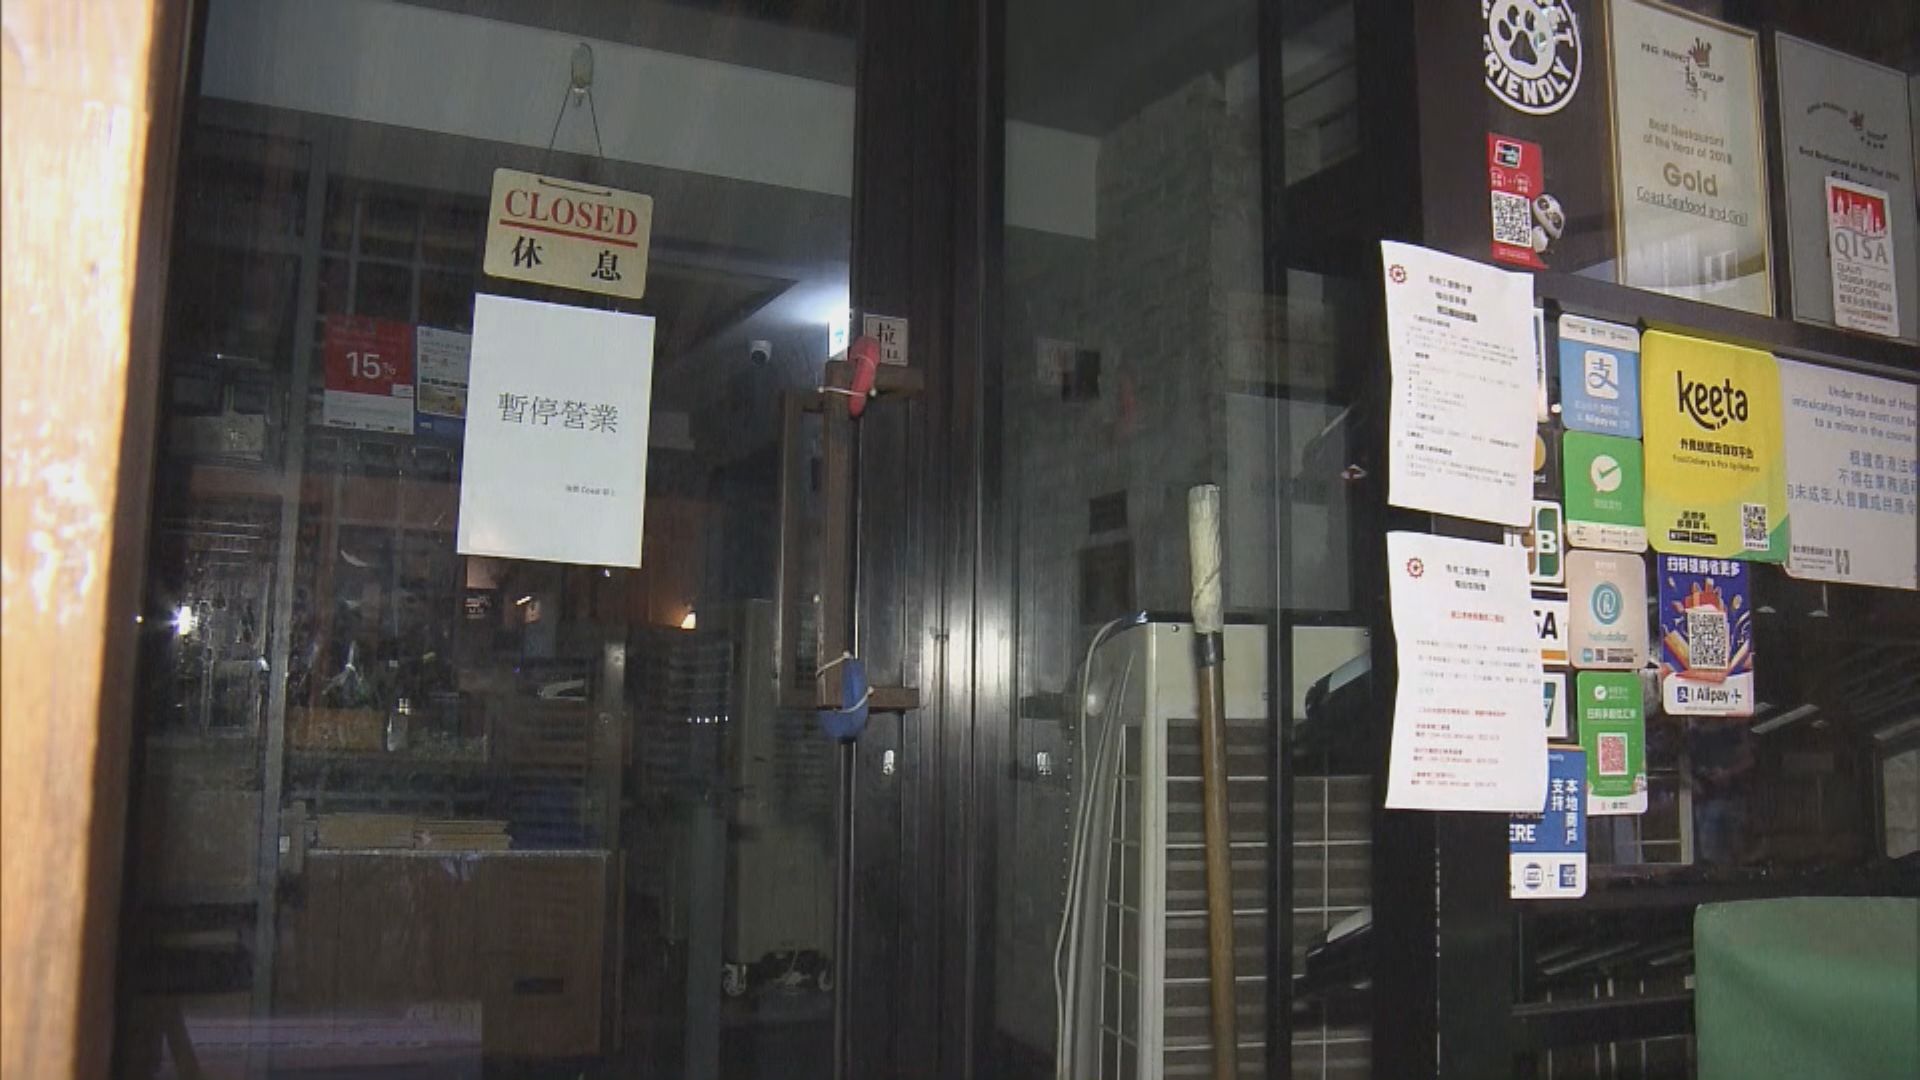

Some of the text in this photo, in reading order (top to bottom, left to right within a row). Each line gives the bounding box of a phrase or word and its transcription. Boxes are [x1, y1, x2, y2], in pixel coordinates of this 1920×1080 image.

[1663, 161, 1718, 198] Gold
[505, 189, 638, 236] CLOSED
[591, 250, 621, 281] 息
[498, 392, 618, 433] 暫停營業
[1677, 370, 1748, 430] keeta
